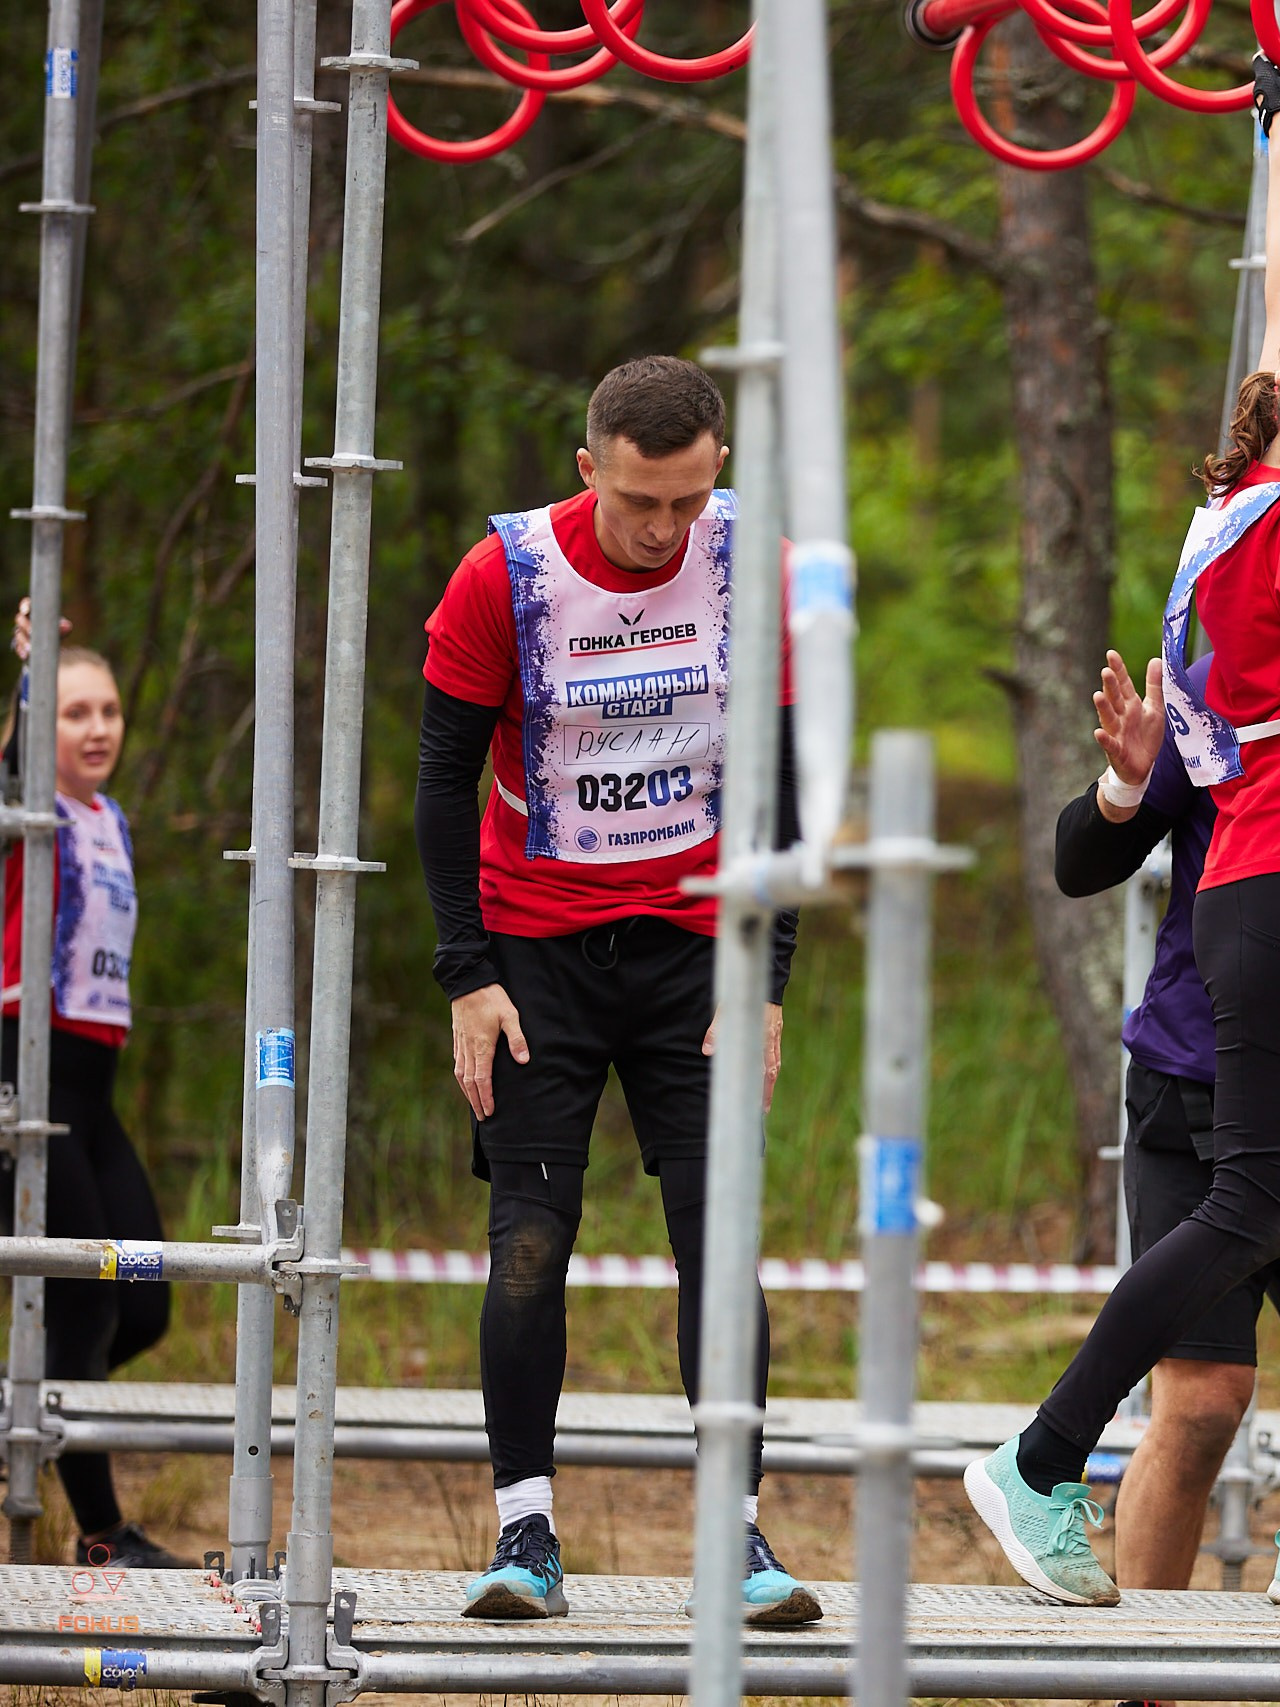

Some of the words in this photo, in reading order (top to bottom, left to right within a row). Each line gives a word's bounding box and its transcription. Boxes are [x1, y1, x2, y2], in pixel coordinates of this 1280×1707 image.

[569, 634, 626, 652] ГОНКА
[630, 623, 697, 646] ГЕРОЕВ
[569, 666, 706, 706] КОМАНДНЫЙ
[606, 699, 669, 716] СТАРТ
[576, 726, 700, 759] РУСЛАН
[576, 765, 694, 812] 03203
[608, 819, 696, 846] ГАЗПРОМБАНК
